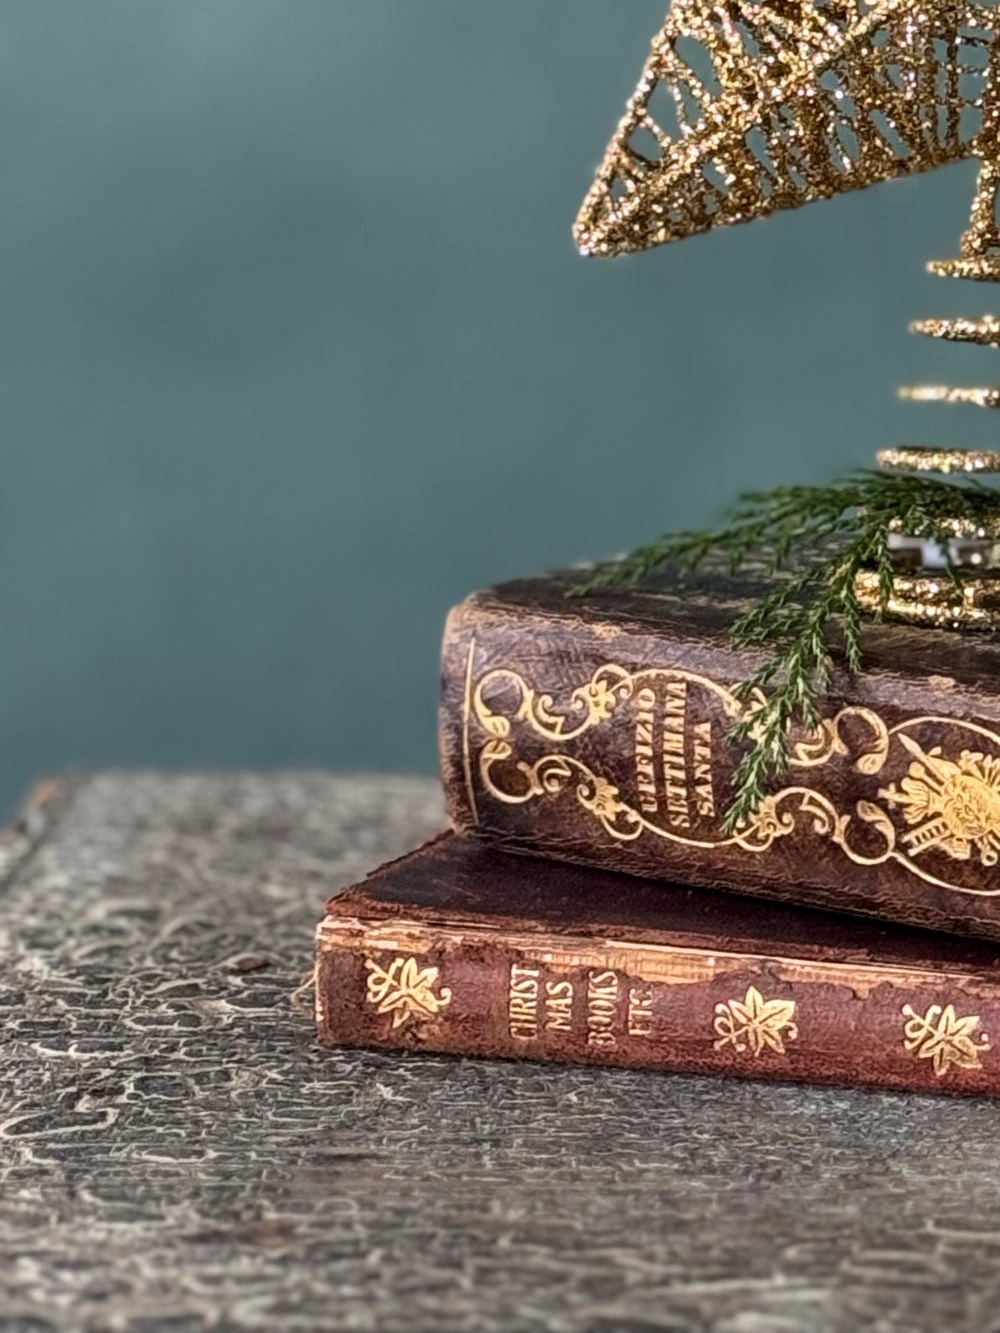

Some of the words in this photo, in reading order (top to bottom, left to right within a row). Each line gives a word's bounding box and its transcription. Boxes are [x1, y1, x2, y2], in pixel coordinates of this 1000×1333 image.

[663, 680, 690, 828] SETTIMANA
[693, 721, 715, 818] SANTA
[508, 962, 540, 1041] CHRIST
[544, 980, 574, 1032] MAS
[587, 970, 618, 1046] BOOKS
